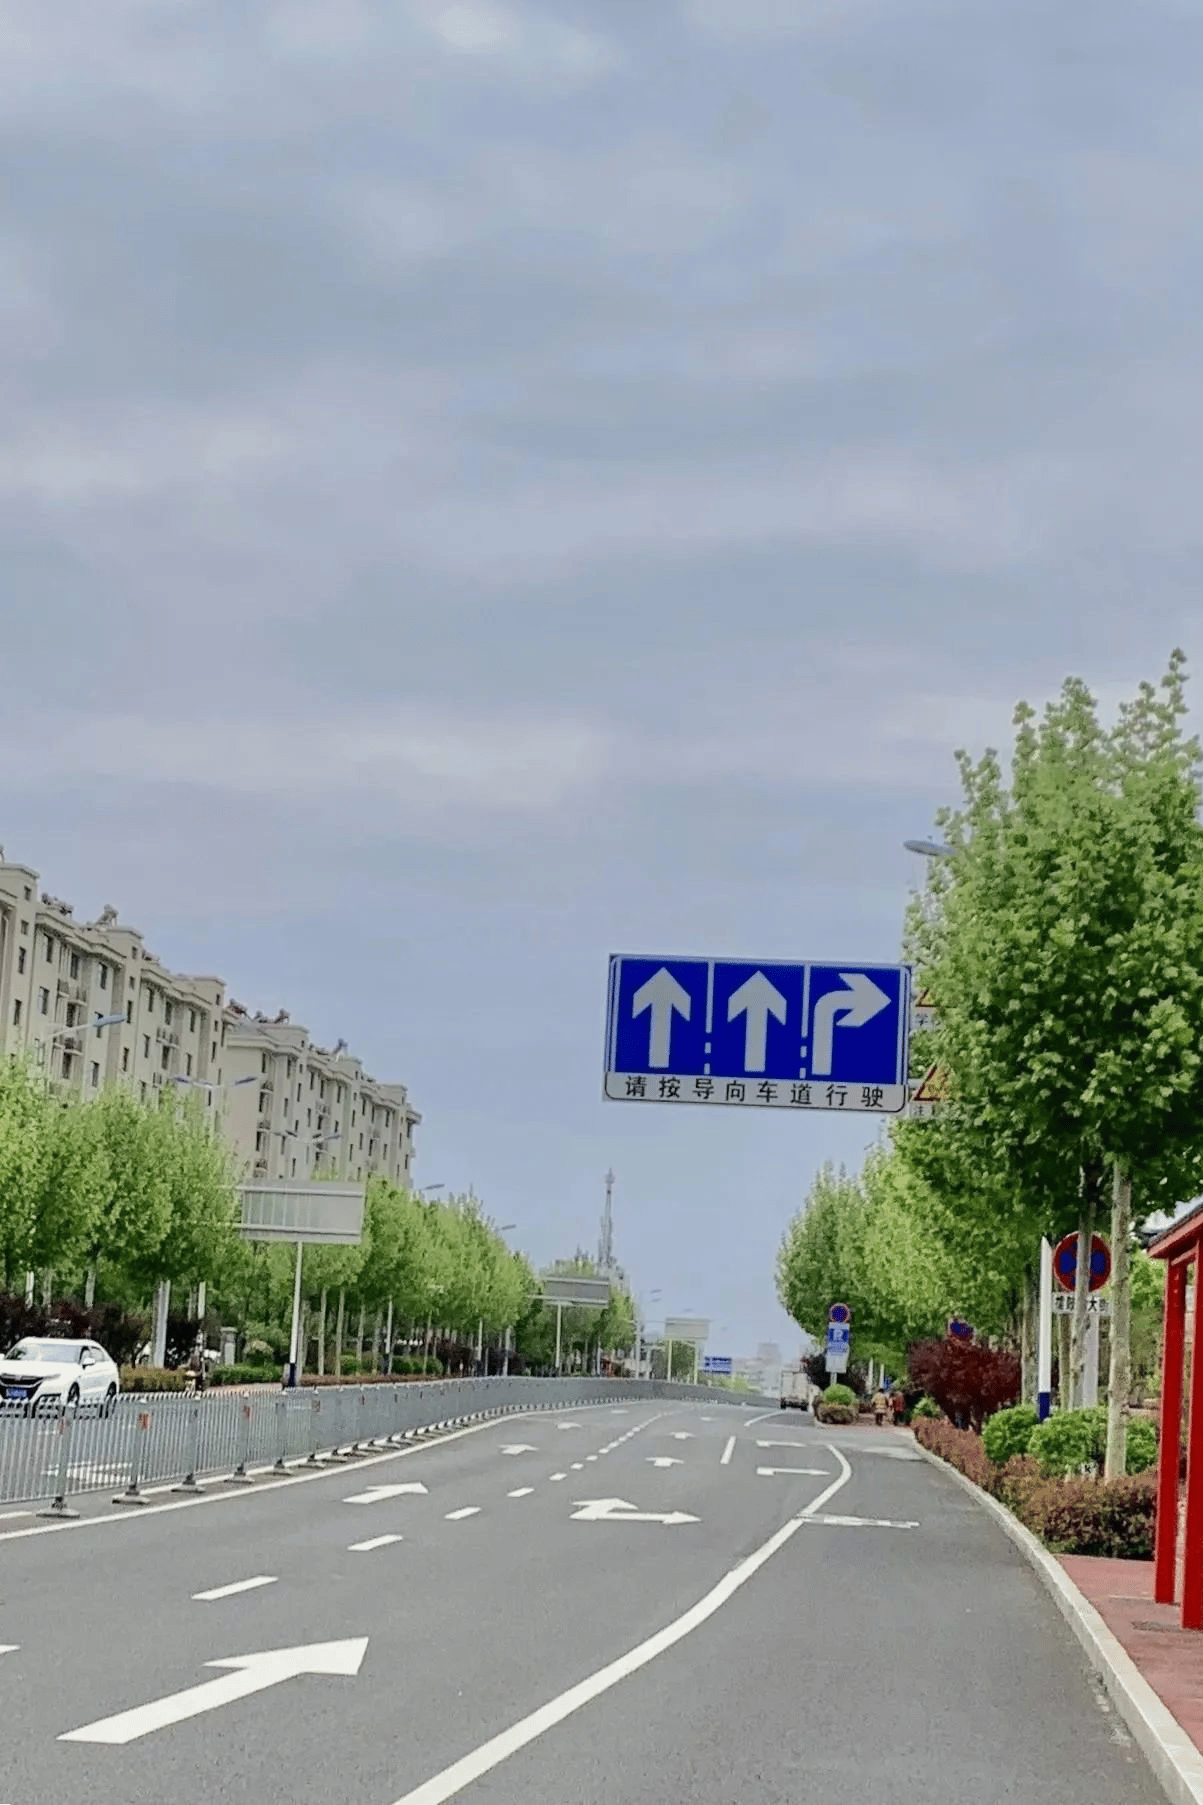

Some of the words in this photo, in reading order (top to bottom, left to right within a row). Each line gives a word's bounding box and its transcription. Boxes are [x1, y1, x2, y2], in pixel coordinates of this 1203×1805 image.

[625, 1075, 885, 1109] 请按导向车道行驶
